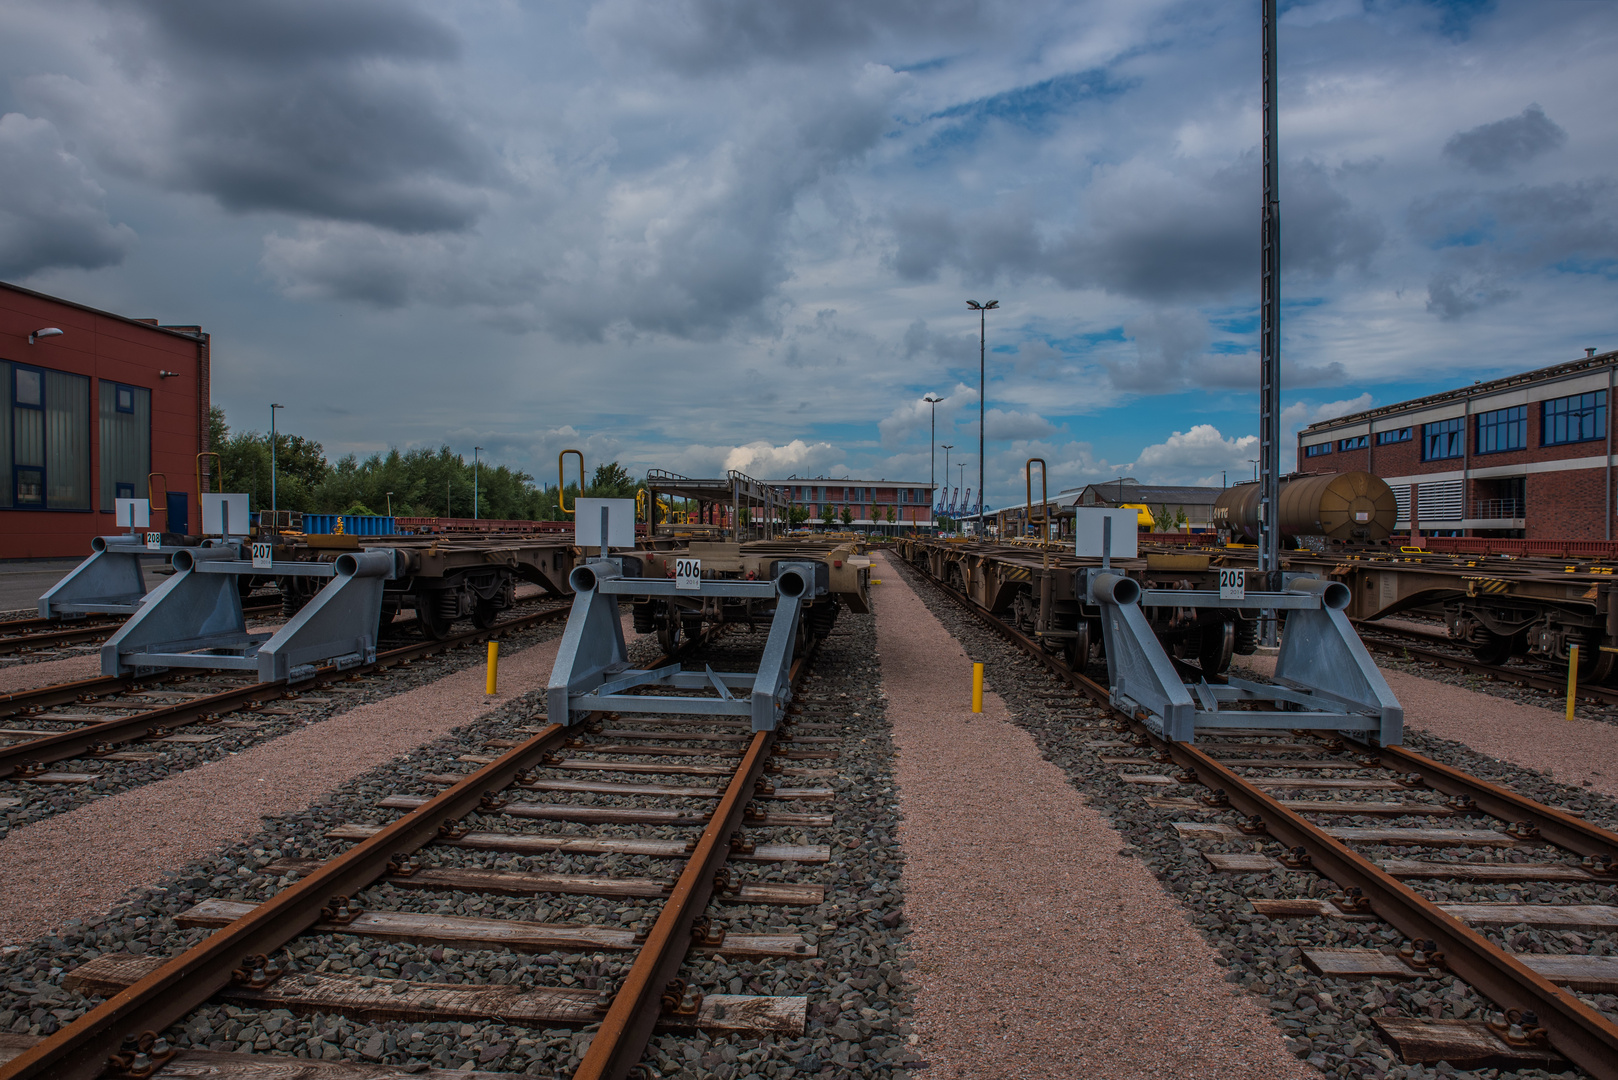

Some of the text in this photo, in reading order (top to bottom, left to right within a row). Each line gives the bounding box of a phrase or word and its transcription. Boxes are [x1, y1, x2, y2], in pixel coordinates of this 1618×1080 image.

[147, 534, 160, 543] 208
[253, 544, 271, 559] 207
[677, 561, 700, 578] 206
[1221, 571, 1243, 588] 205
